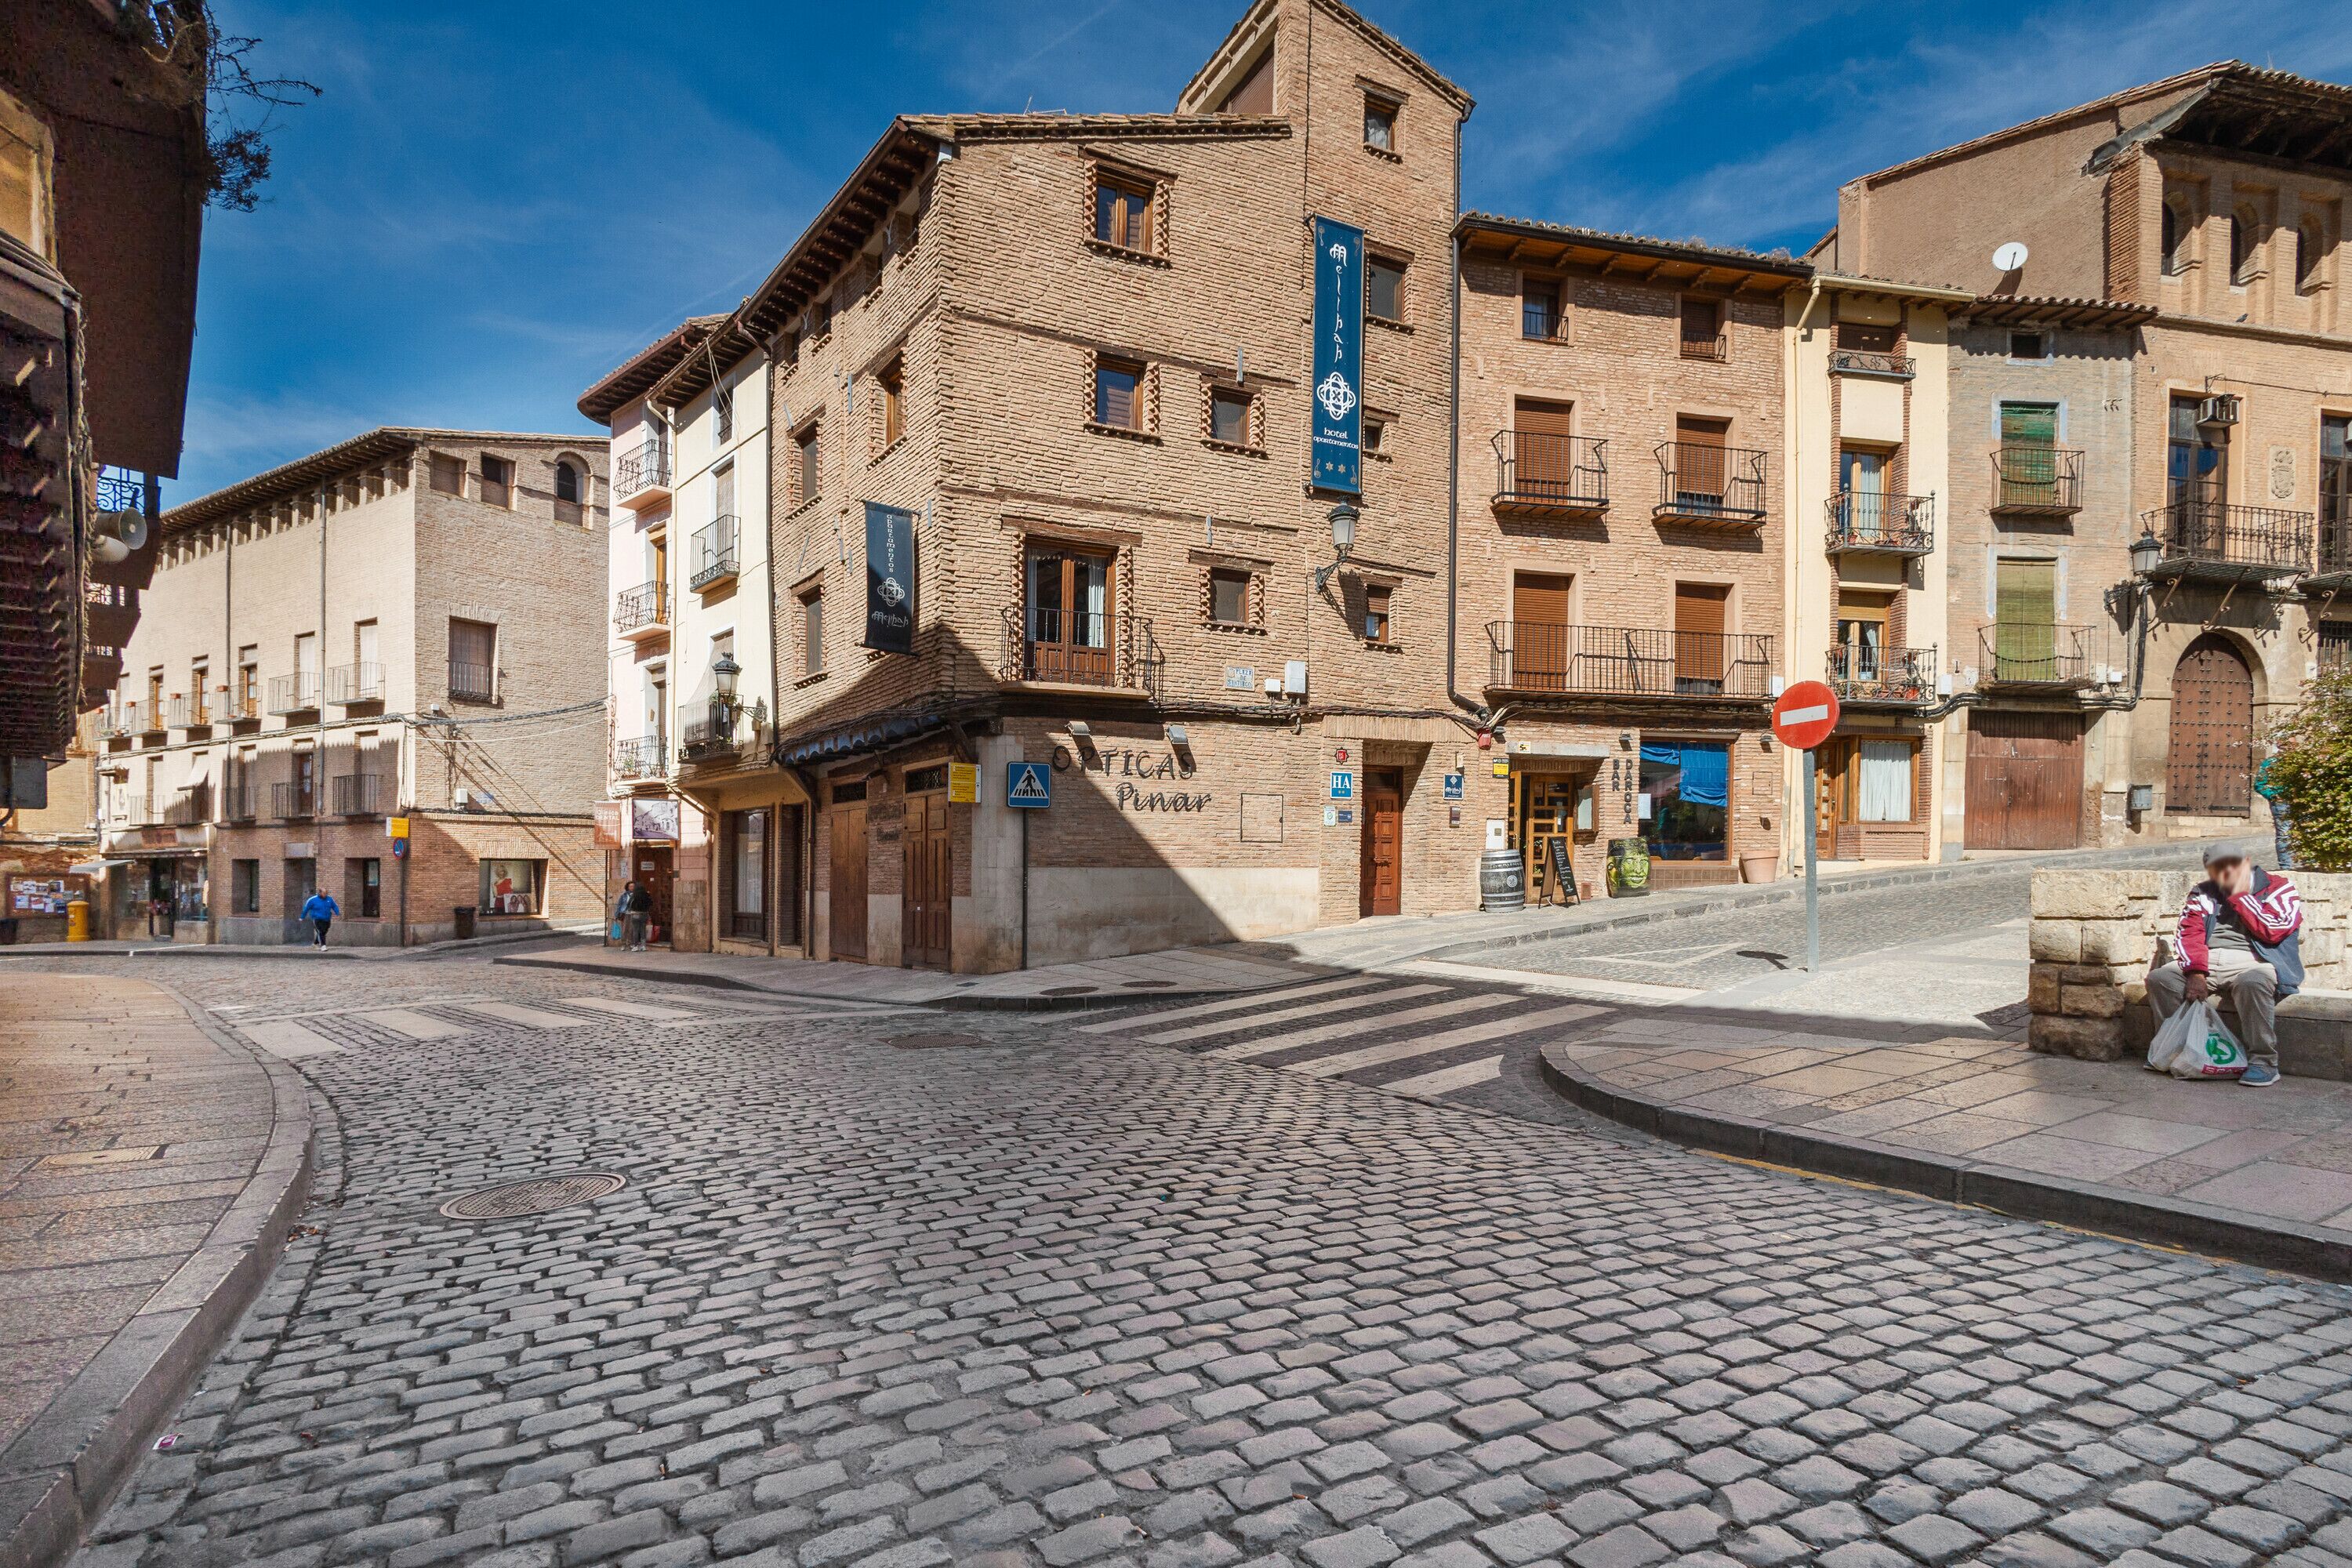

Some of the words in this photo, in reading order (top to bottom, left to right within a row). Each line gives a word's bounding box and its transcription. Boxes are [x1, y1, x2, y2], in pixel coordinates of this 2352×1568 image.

[1313, 436, 1359, 450] apartamentos
[1323, 427, 1348, 439] hotel
[886, 514, 895, 573] apartamentos
[1052, 746, 1193, 780] OPTICAS
[1611, 759, 1620, 792] BAR
[1116, 782, 1212, 813] Pinar
[1332, 775, 1351, 789] HA
[1623, 758, 1633, 825] DAROCA
